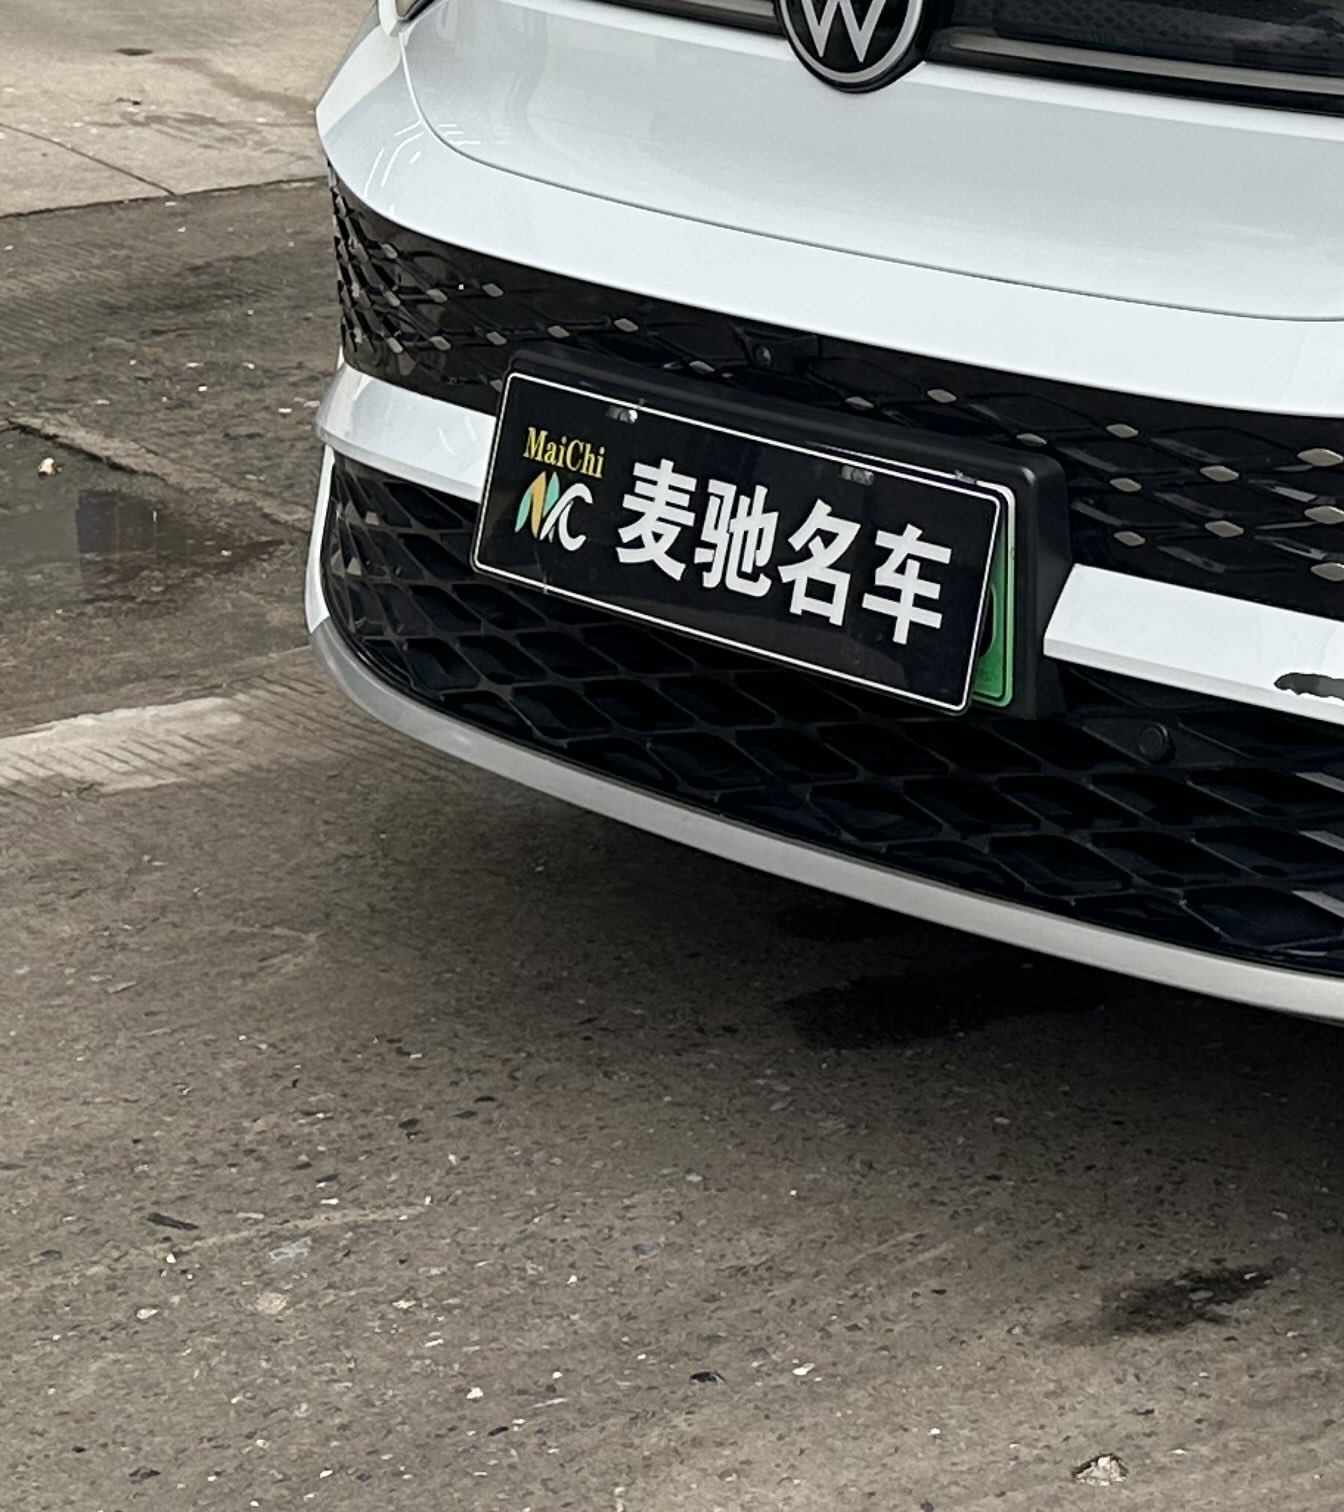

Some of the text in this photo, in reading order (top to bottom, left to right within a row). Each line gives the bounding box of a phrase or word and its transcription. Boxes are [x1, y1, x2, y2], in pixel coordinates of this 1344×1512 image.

[523, 426, 605, 479] MaiChi
[615, 458, 952, 645] 麦驰名车
